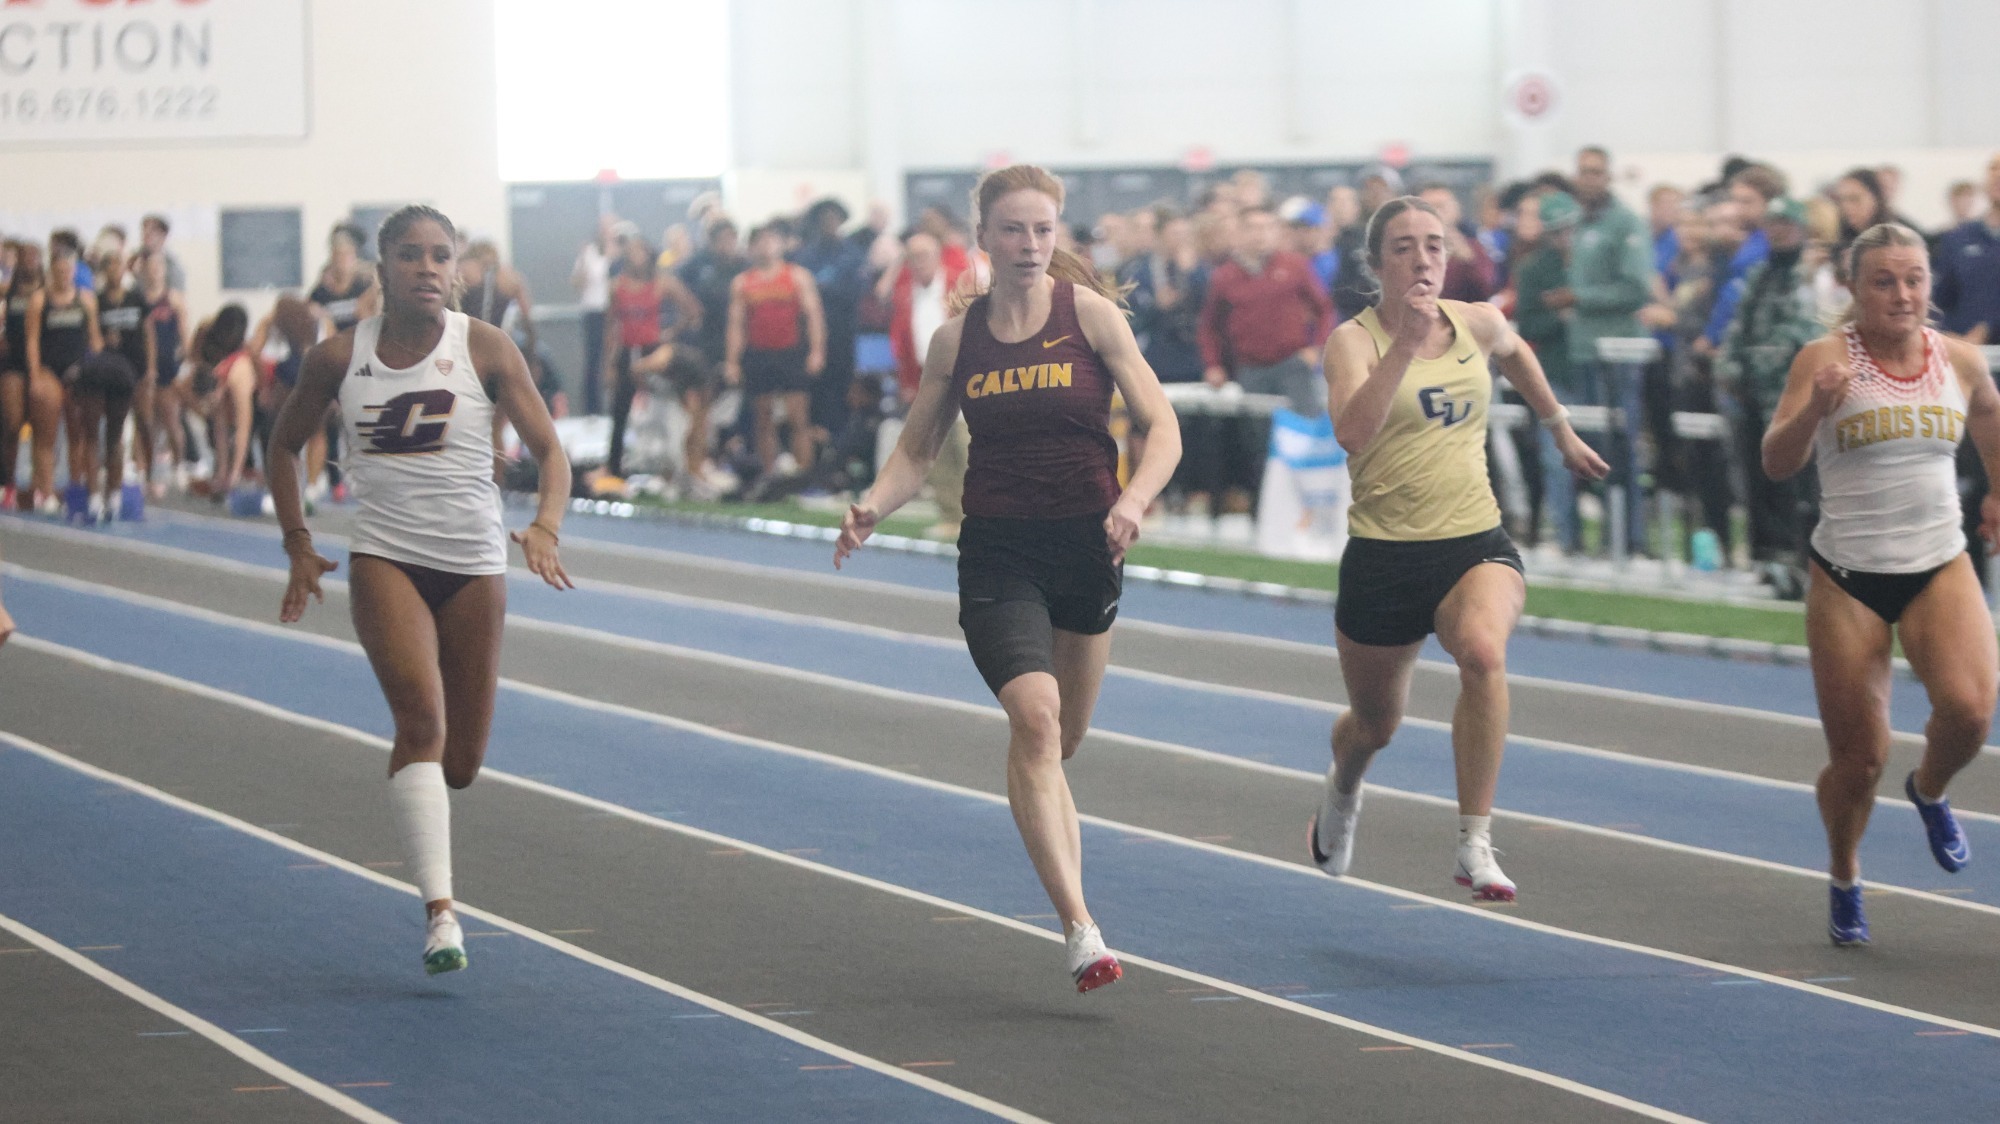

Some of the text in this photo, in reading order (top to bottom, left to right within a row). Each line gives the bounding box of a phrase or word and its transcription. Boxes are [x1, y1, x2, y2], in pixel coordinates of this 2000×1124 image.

[0, 18, 212, 75] CTION
[966, 362, 1073, 399] CALVIN
[1836, 405, 1915, 453] FERRIS
